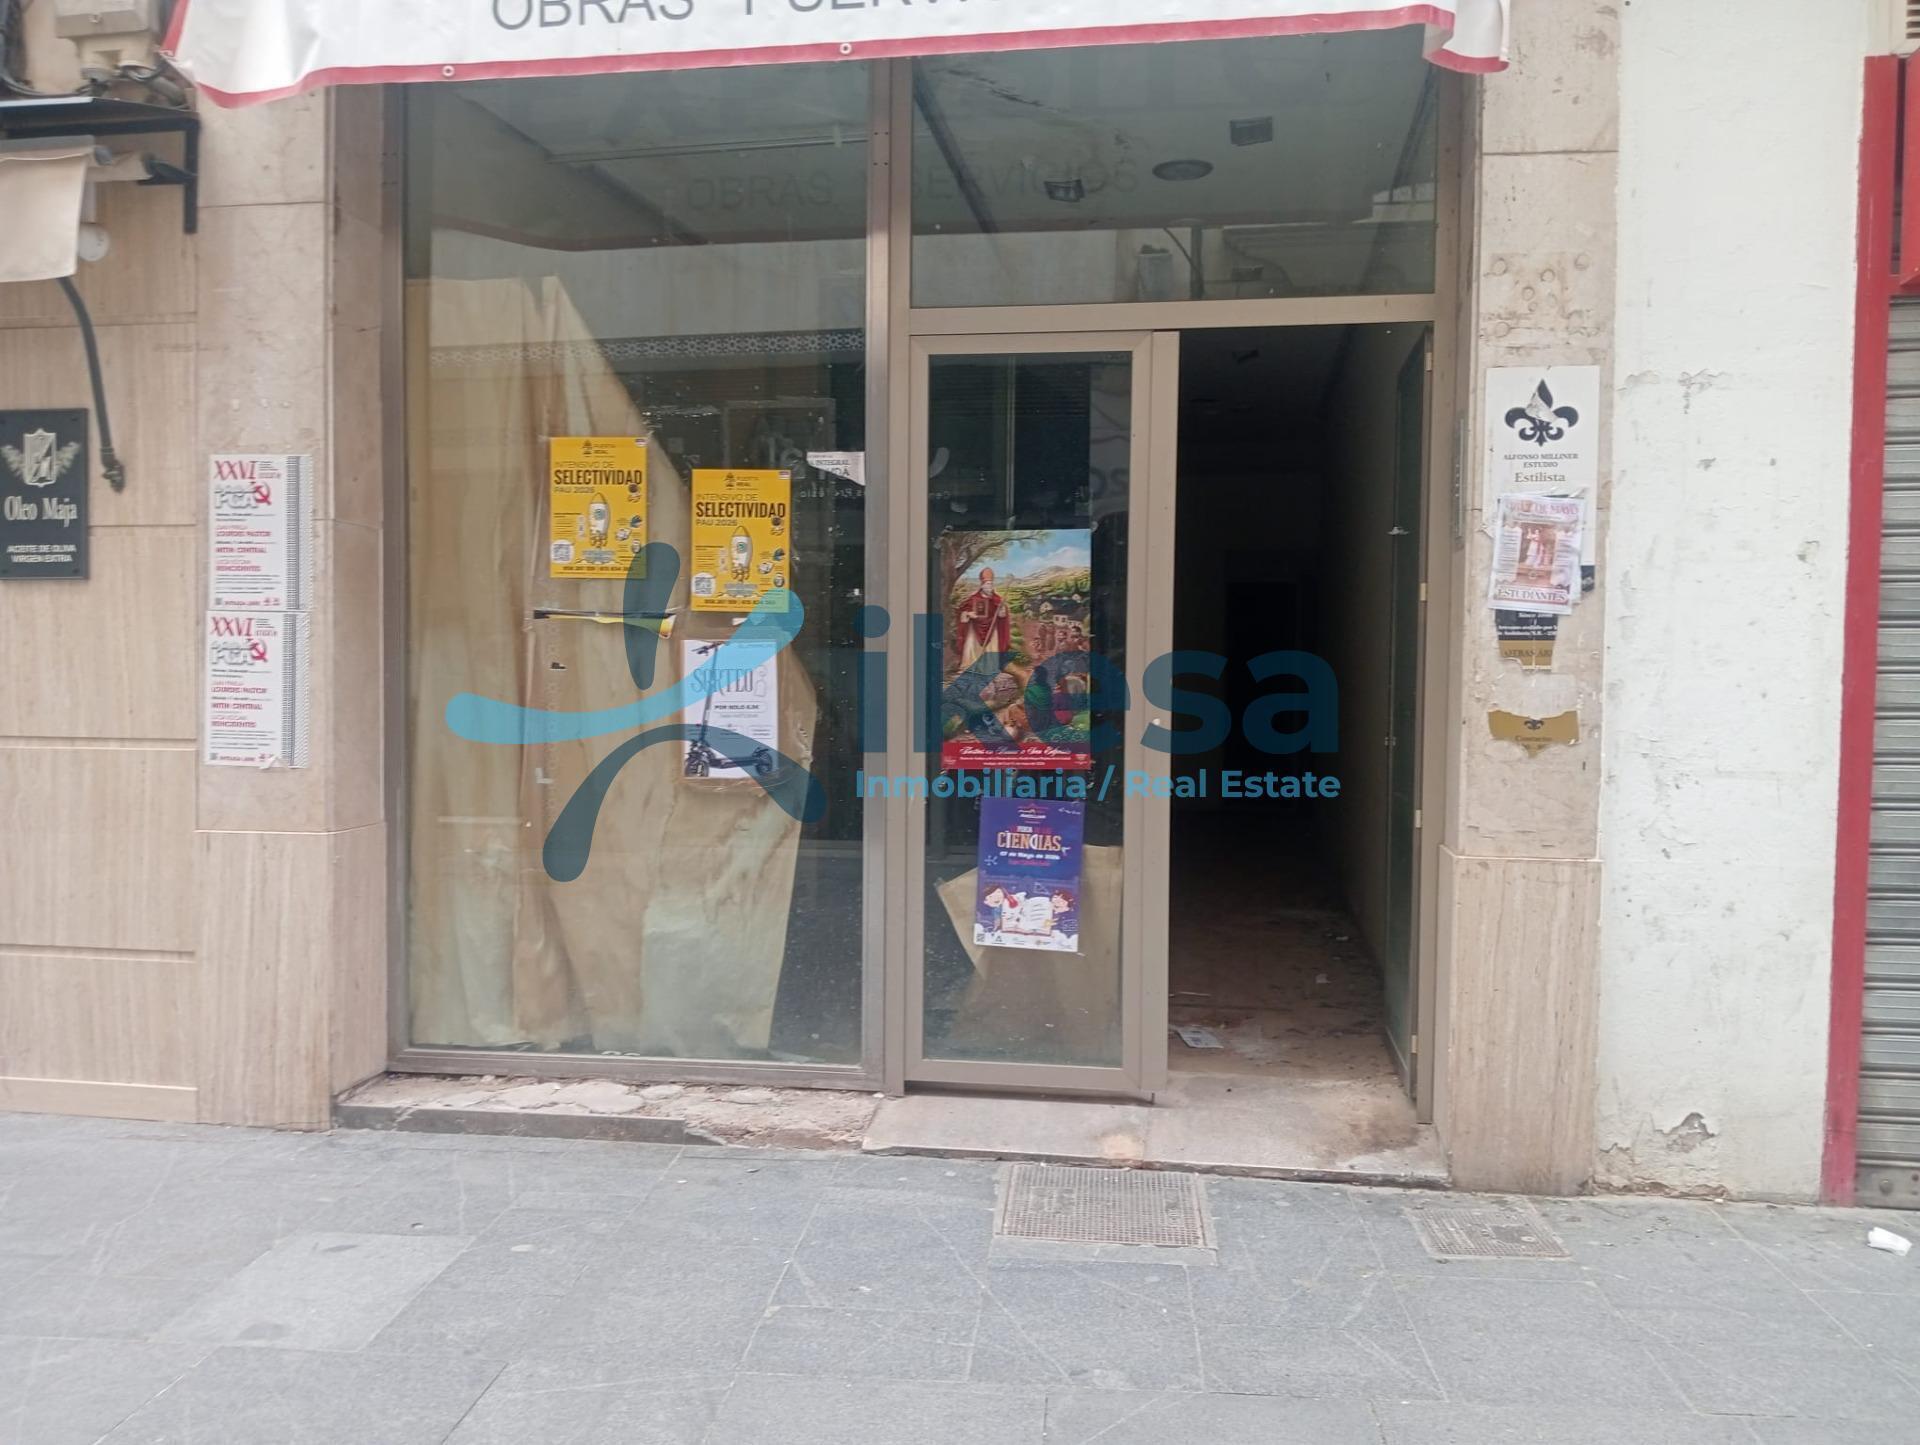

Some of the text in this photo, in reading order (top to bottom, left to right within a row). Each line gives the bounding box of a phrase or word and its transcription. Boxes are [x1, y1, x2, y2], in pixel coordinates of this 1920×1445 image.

[214, 460, 257, 481] XXVI
[554, 469, 643, 486] SELECTIVIDAD
[1514, 472, 1566, 483] Estilista
[745, 494, 760, 502] DE
[42, 497, 78, 528] Maja
[695, 502, 787, 518] SELECTIVIDAD
[1498, 588, 1567, 602] ESTUDIANTES
[210, 616, 254, 638] XXVI
[997, 831, 1062, 851] CIENCIAS
